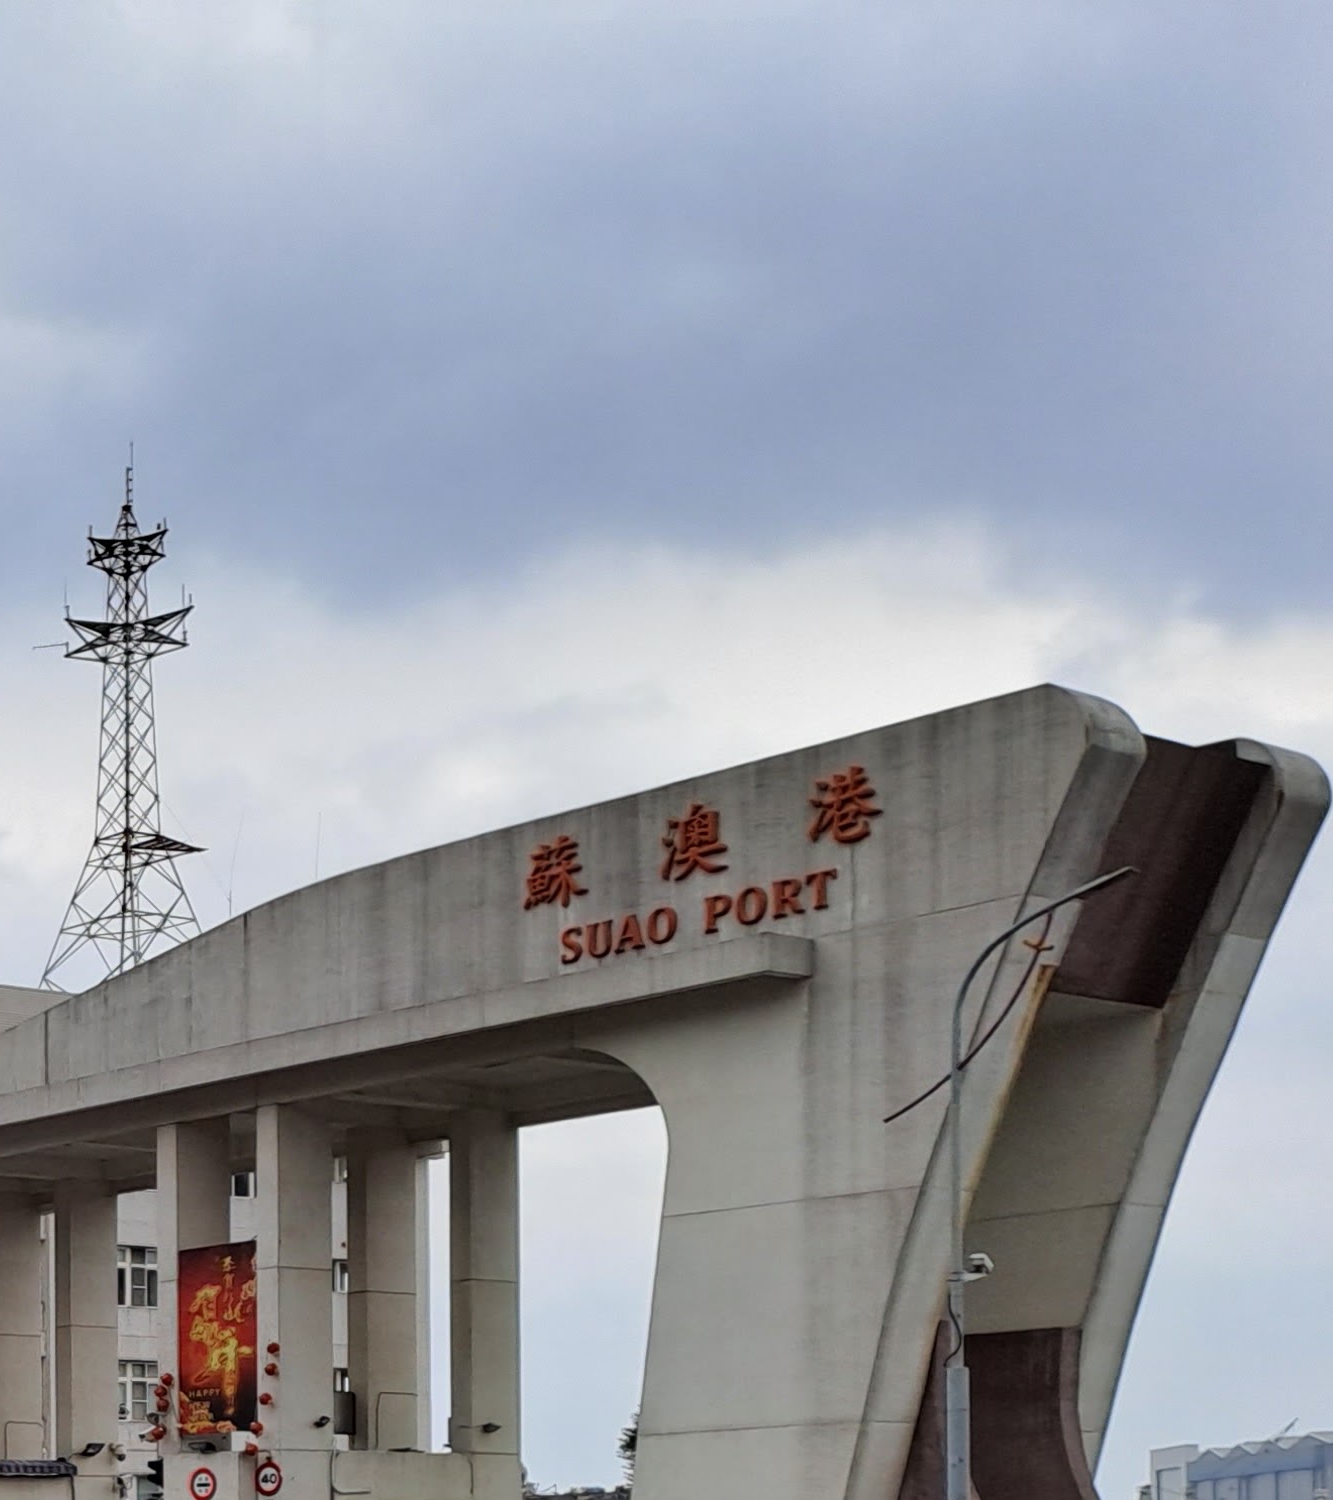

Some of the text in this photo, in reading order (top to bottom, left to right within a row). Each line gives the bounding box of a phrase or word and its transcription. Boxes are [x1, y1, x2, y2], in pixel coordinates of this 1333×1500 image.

[522, 765, 883, 912] 蘇澳港
[560, 867, 837, 965] SUAO PORT
[188, 1387, 221, 1398] HAPPY
[261, 1473, 277, 1484] 40
